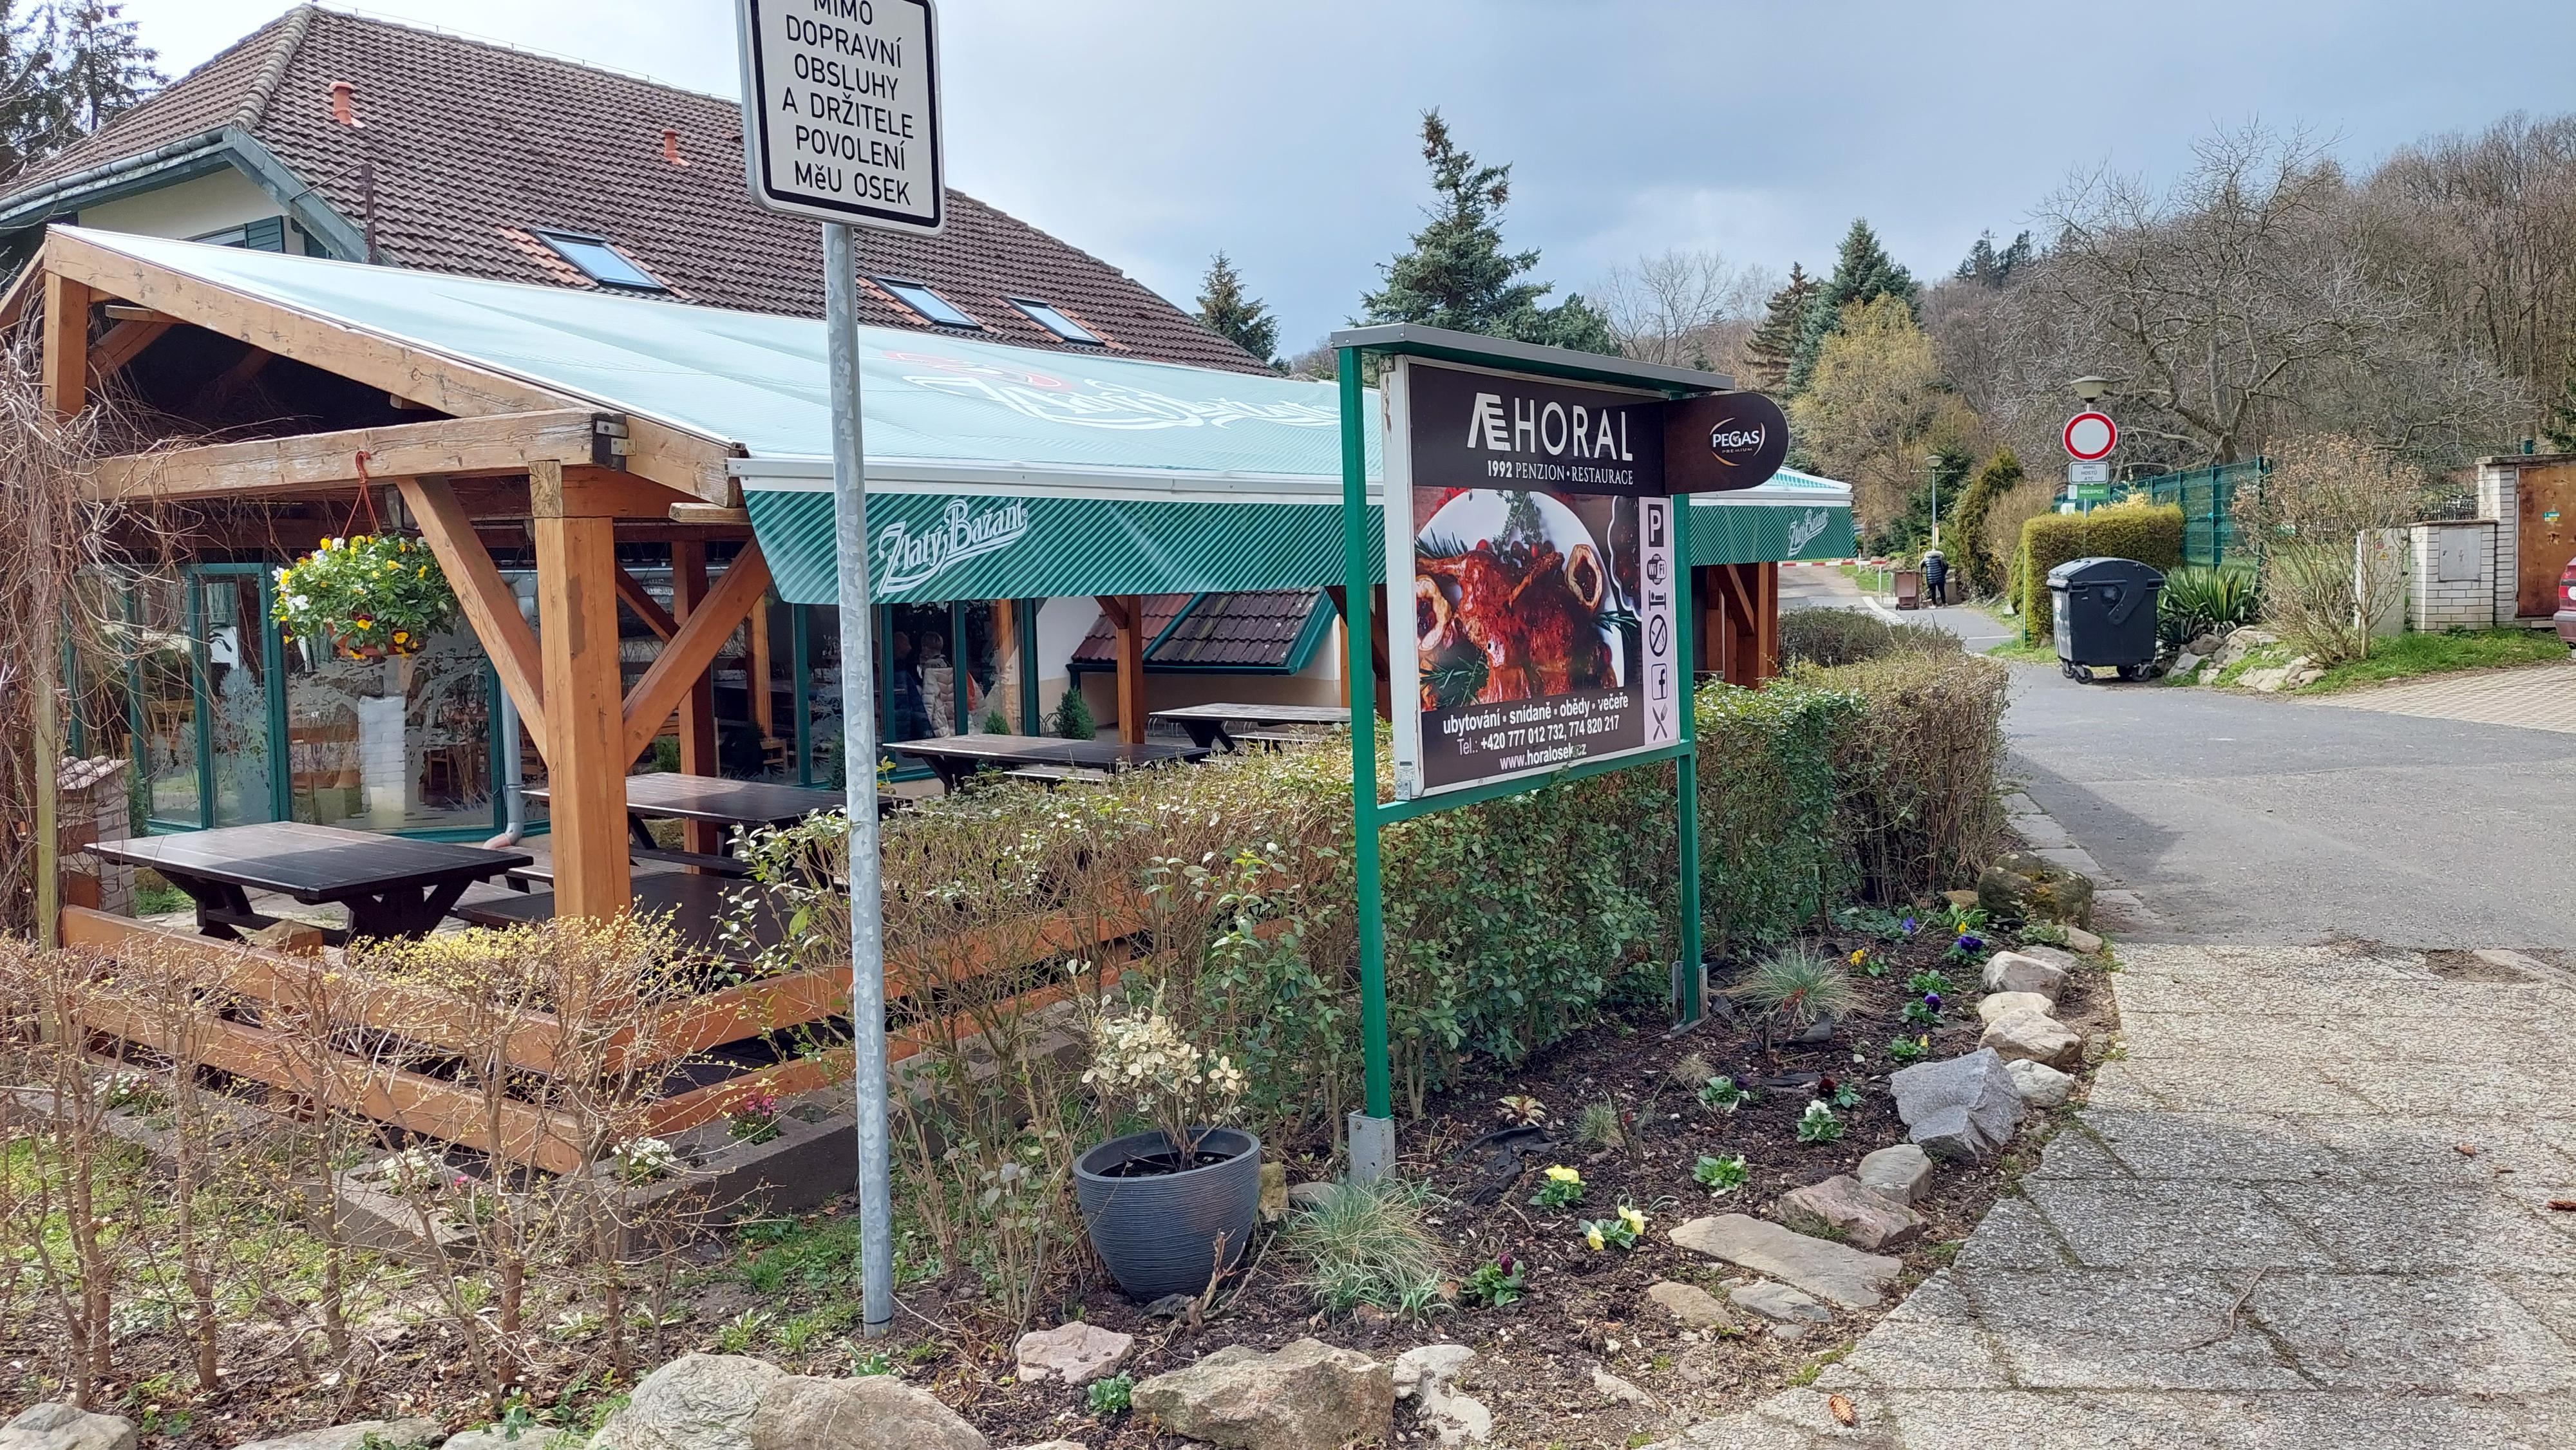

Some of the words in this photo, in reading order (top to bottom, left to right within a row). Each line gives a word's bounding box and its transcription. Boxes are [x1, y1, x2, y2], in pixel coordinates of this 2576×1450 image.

[786, 14, 902, 68] DOPRAVNÍ
[794, 53, 899, 101] OBSLUHY
[782, 86, 799, 115] A
[810, 91, 914, 140] DRŽITELE
[795, 124, 905, 171] POVOLENÍ
[794, 160, 842, 193] MěU
[854, 173, 912, 206] OSEK
[1712, 429, 1760, 447] PEGAS
[1487, 460, 1513, 478] 1992
[1515, 462, 1566, 481] PENZION
[1571, 466, 1634, 485] RESTAURACE
[876, 520, 948, 598] Zlatý
[943, 498, 1028, 564] Bažant
[1443, 708, 1501, 737] ubytování
[1509, 701, 1551, 725] snídaně
[1560, 697, 1590, 718] obědy
[1598, 692, 1629, 711] večeře
[1457, 737, 1478, 756] Tel.:
[1481, 731, 1506, 751] +420
[1507, 729, 1526, 748] 777
[1528, 726, 1546, 744] 012
[1547, 722, 1567, 741] 732,
[1568, 719, 1586, 738] 774
[1587, 717, 1603, 735] 820
[1604, 714, 1620, 731] 217
